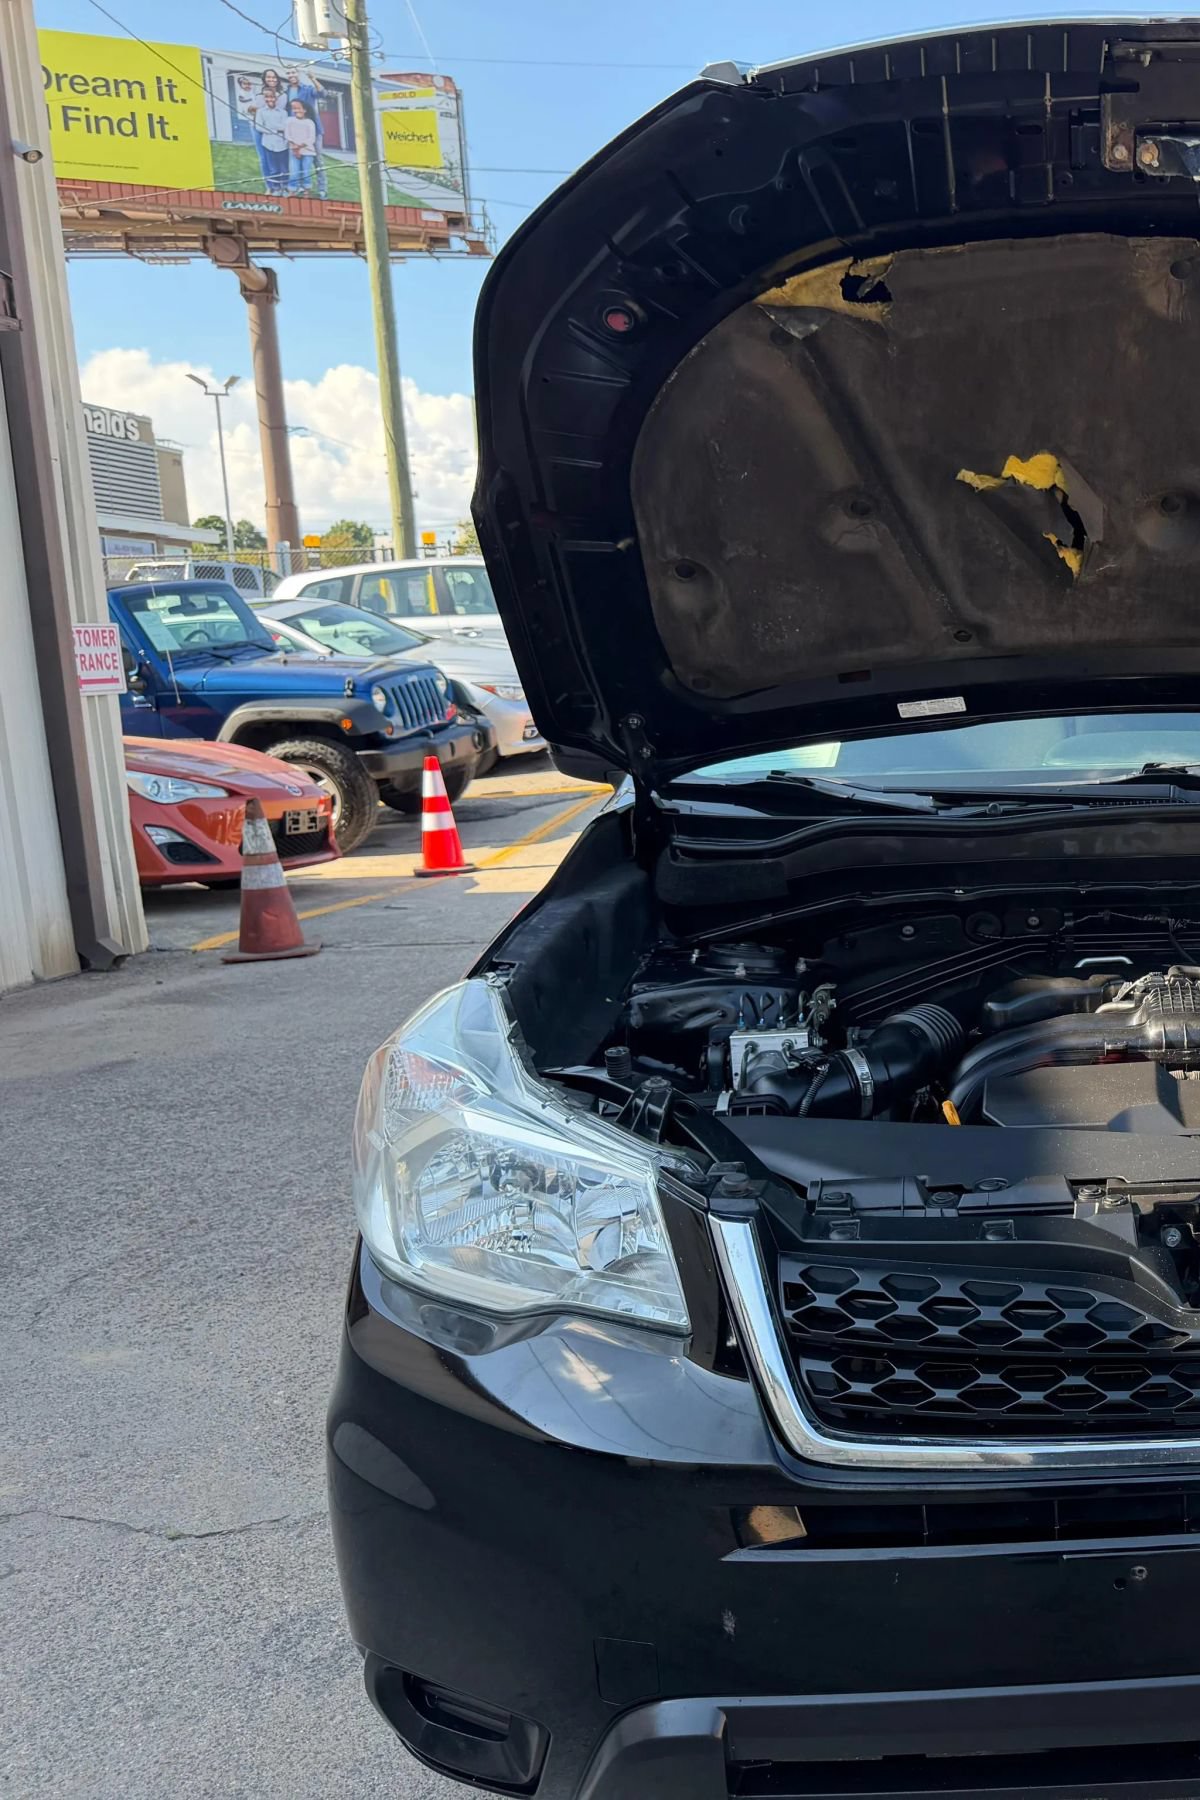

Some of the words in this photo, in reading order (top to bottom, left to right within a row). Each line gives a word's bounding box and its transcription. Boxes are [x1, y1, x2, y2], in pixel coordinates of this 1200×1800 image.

[156, 76, 187, 104] It.
[62, 105, 138, 137] Find
[148, 113, 179, 141] It.
[386, 131, 435, 143] Weichert
[227, 202, 279, 212] LAMAR
[75, 653, 118, 671] RANCE
